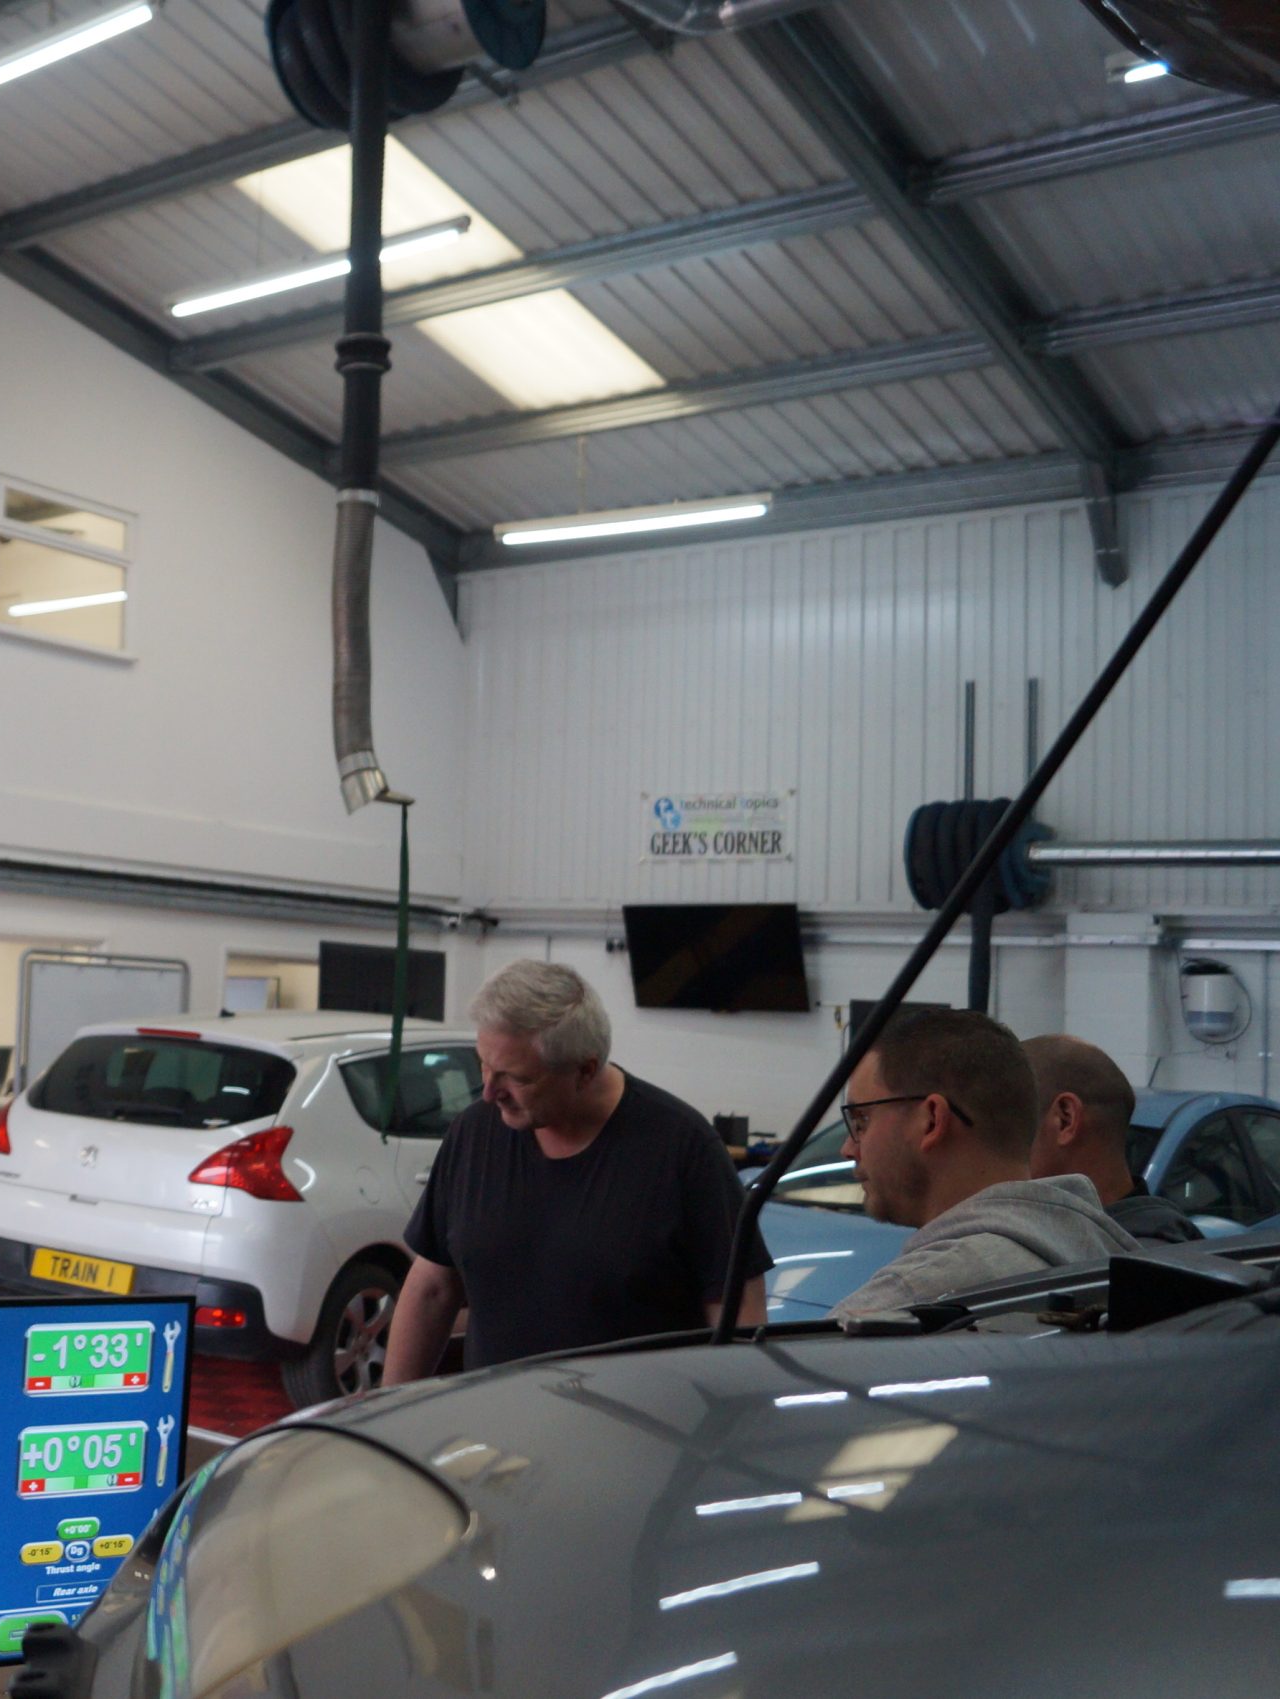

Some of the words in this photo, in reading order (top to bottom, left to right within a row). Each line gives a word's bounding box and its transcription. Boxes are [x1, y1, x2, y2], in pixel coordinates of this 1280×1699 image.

[680, 796, 736, 810] technical
[739, 796, 780, 812] topics
[651, 831, 708, 856] GEEK'S
[713, 830, 782, 855] CORNER
[50, 1255, 99, 1283] TRAIN
[45, 1565, 75, 1575] Thrust
[76, 1562, 101, 1573] angle
[53, 1587, 75, 1597] Rear
[77, 1585, 98, 1595] axle
